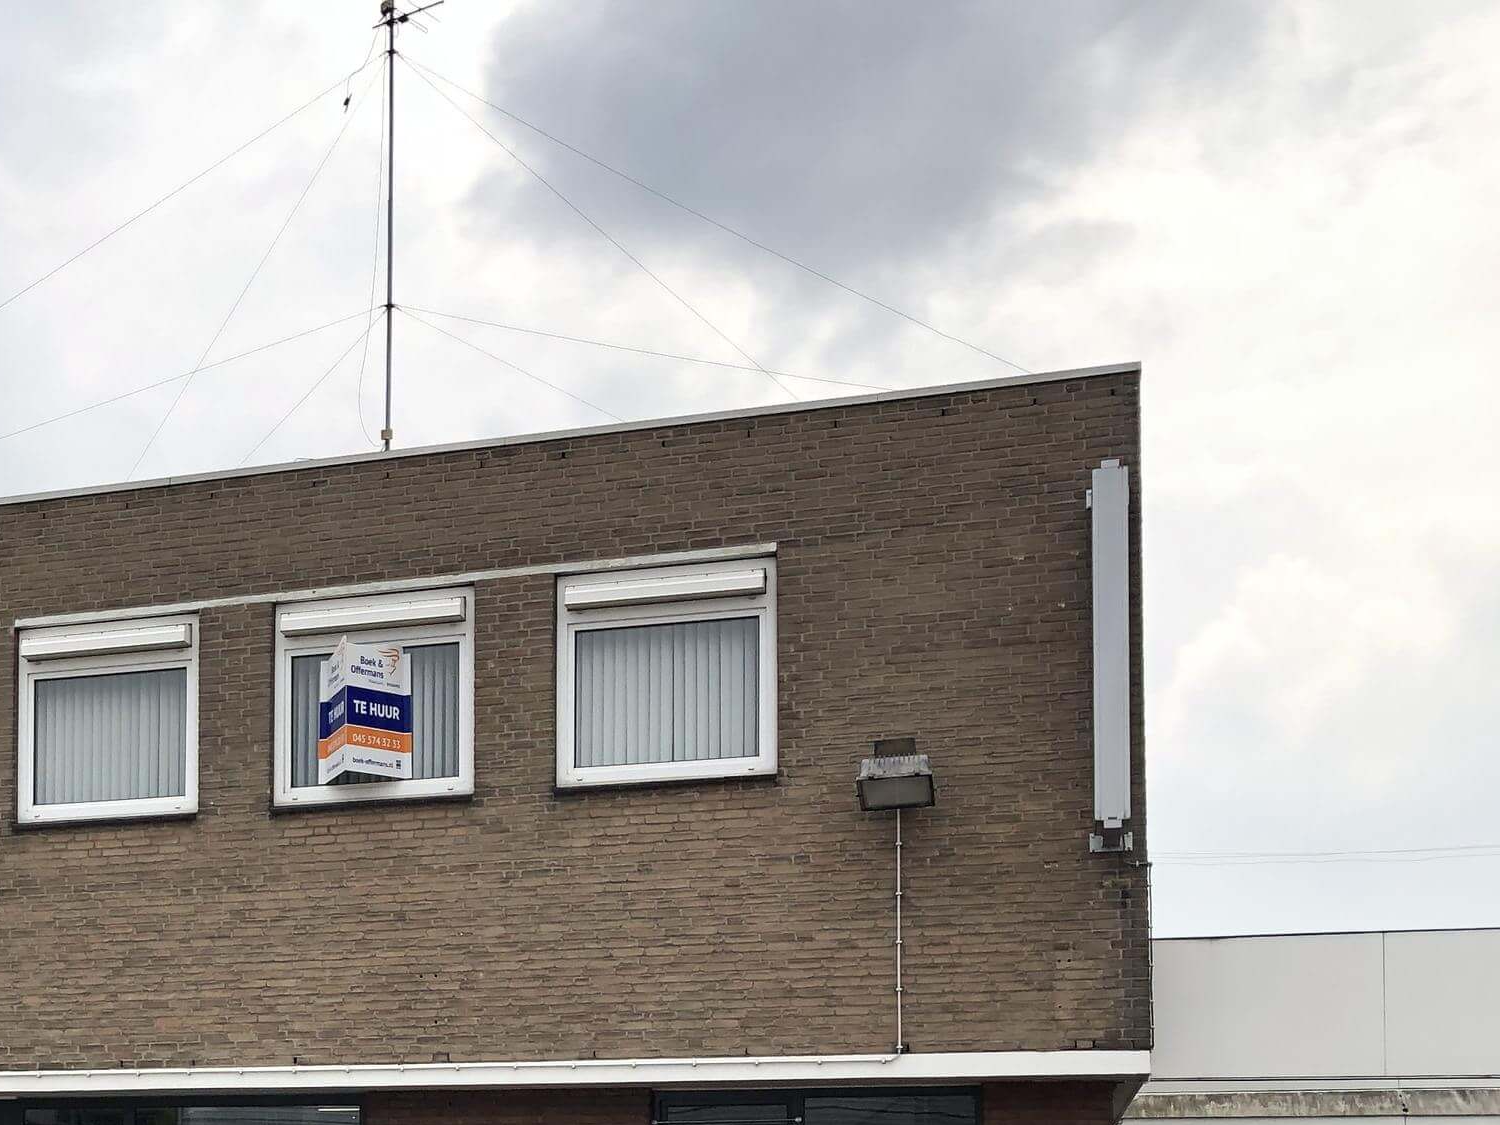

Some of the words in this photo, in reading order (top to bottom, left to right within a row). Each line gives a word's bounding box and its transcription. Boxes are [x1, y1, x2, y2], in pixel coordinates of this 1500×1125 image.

[360, 655, 376, 667] Boek
[378, 659, 384, 668] &
[350, 664, 384, 679] Offermans
[353, 699, 367, 714] TE
[369, 702, 400, 721] HUUR
[352, 733, 366, 744] 045
[367, 736, 381, 746] 574
